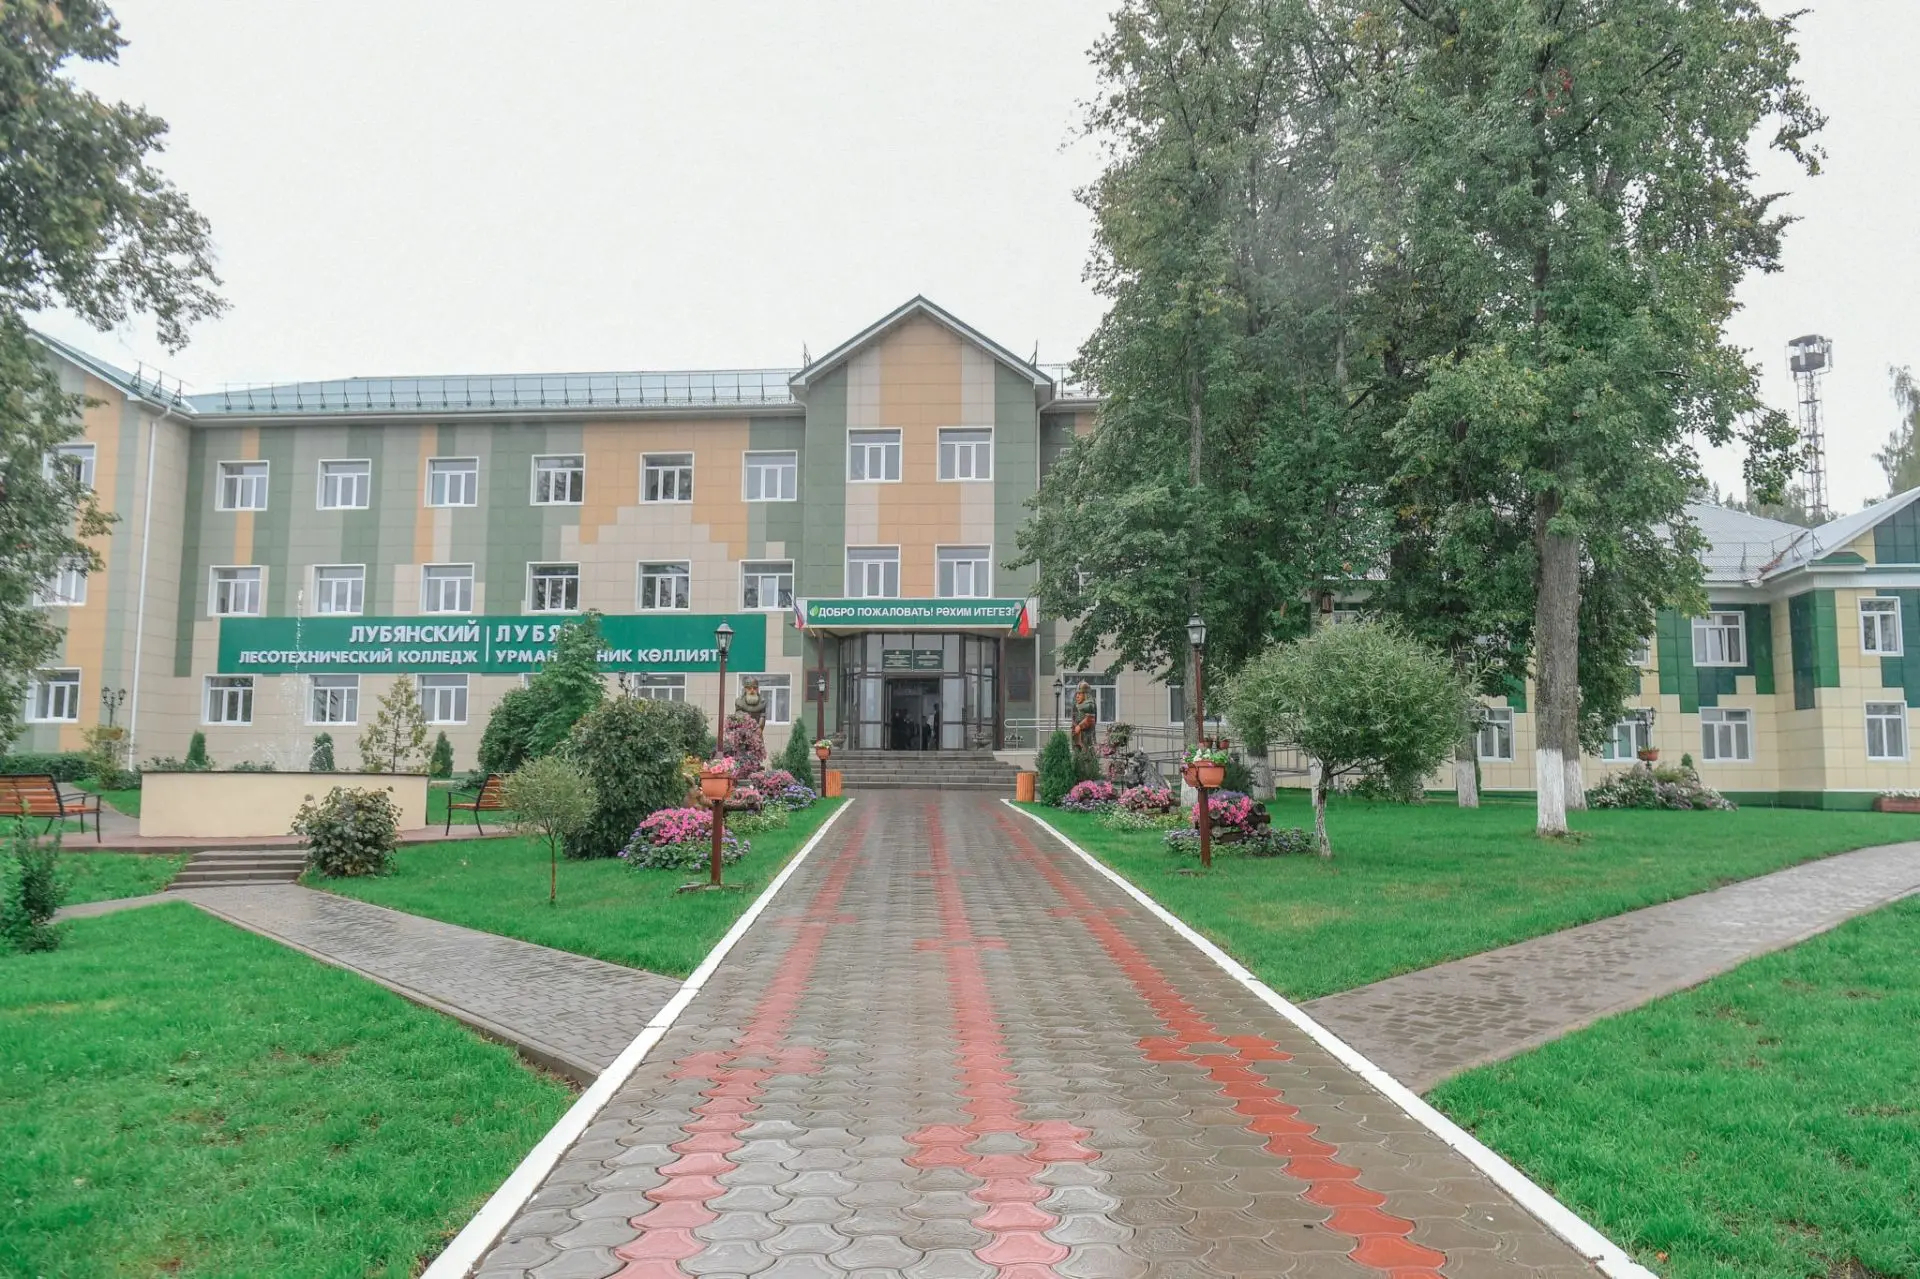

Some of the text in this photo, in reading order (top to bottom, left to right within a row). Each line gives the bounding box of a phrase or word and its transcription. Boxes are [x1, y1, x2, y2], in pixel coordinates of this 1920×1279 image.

[818, 607, 855, 618] ДОБРО
[857, 607, 934, 617] ПОЖАЛОВАТЬ!
[936, 607, 972, 617] РӘХИМ
[349, 619, 480, 643] ЛУБЯНСКИЙ
[495, 624, 569, 643] ЛУБЯ
[238, 647, 478, 665] ЛЕСОТЕХНИЧЕСКИЙ КОЛЛЕДЖ
[637, 648, 728, 662] КӨЛЛИЯТ
